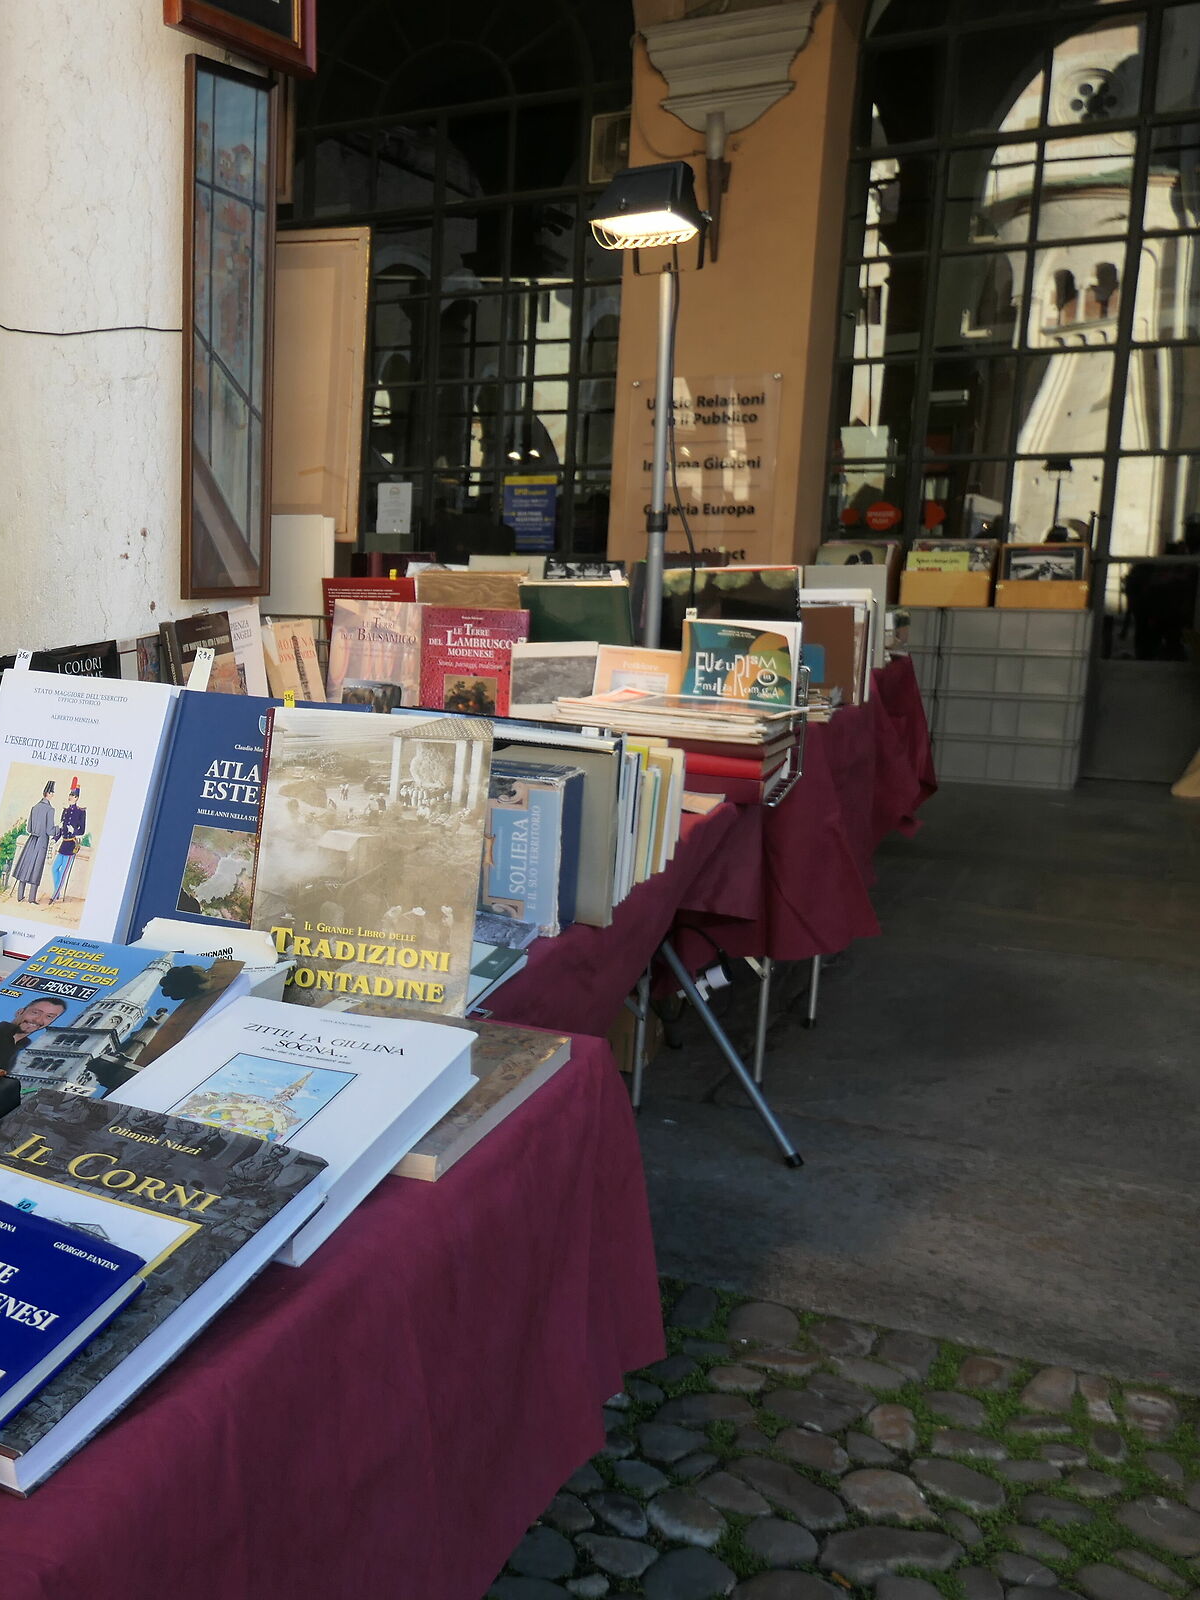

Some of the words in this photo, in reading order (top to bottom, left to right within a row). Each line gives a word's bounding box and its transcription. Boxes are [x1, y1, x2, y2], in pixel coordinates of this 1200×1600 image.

[696, 392, 766, 408] Relazioni
[693, 411, 758, 426] Pubblico
[643, 502, 699, 516] Glleria
[702, 503, 756, 518] Europa
[357, 628, 418, 644] BALSAMICO
[428, 637, 444, 646] DEL
[446, 629, 513, 650] LAMBRUSCO
[452, 626, 464, 635] LE
[464, 623, 490, 637] TERRE
[447, 648, 495, 659] MODENESE
[64, 657, 103, 675] COLORI
[33, 687, 53, 695] STATO
[54, 689, 85, 699] MAGGIORE
[85, 692, 129, 703] DELL'ESERCITO
[57, 696, 79, 705] UFFICIO
[51, 714, 74, 722] ALBERTO
[4, 734, 45, 749] L'ESERCITO
[45, 740, 60, 751] DEL
[60, 742, 91, 754] DUCATO
[91, 745, 101, 756] DI
[101, 746, 134, 760] MODENA
[234, 743, 254, 752] Claudio
[31, 750, 47, 760] DAL
[48, 752, 67, 764] 1848
[67, 754, 78, 765] AL
[80, 756, 100, 768] 1859
[204, 759, 262, 783] ATLA
[200, 780, 260, 805] ESTE
[196, 808, 215, 816] MILLE
[230, 813, 248, 821] NELLA
[530, 804, 542, 865] TERRITORIO
[508, 817, 530, 895] SOLIERA
[304, 921, 313, 931] IL
[316, 922, 354, 936] GRANDE
[357, 926, 386, 939] LIBRO
[389, 931, 417, 943] DELLE
[270, 926, 451, 972] TRADIZIONI
[26, 963, 44, 972] SI
[43, 967, 79, 980] DICE
[35, 955, 49, 963] A
[50, 955, 120, 976] MODENA
[14, 974, 40, 988] MO
[78, 987, 96, 1000] TE
[243, 1022, 295, 1038] ZITTI!
[299, 1033, 322, 1044] LA
[330, 1038, 405, 1056] GIULINA
[274, 1039, 349, 1059] SOGNA...
[108, 1125, 161, 1147] Olimpia
[162, 1137, 203, 1156] Nuzzi
[4, 1132, 54, 1167] IL
[66, 1152, 222, 1215] CORNI
[52, 1240, 89, 1259] GIORGIO
[86, 1253, 120, 1271] FANTINI
